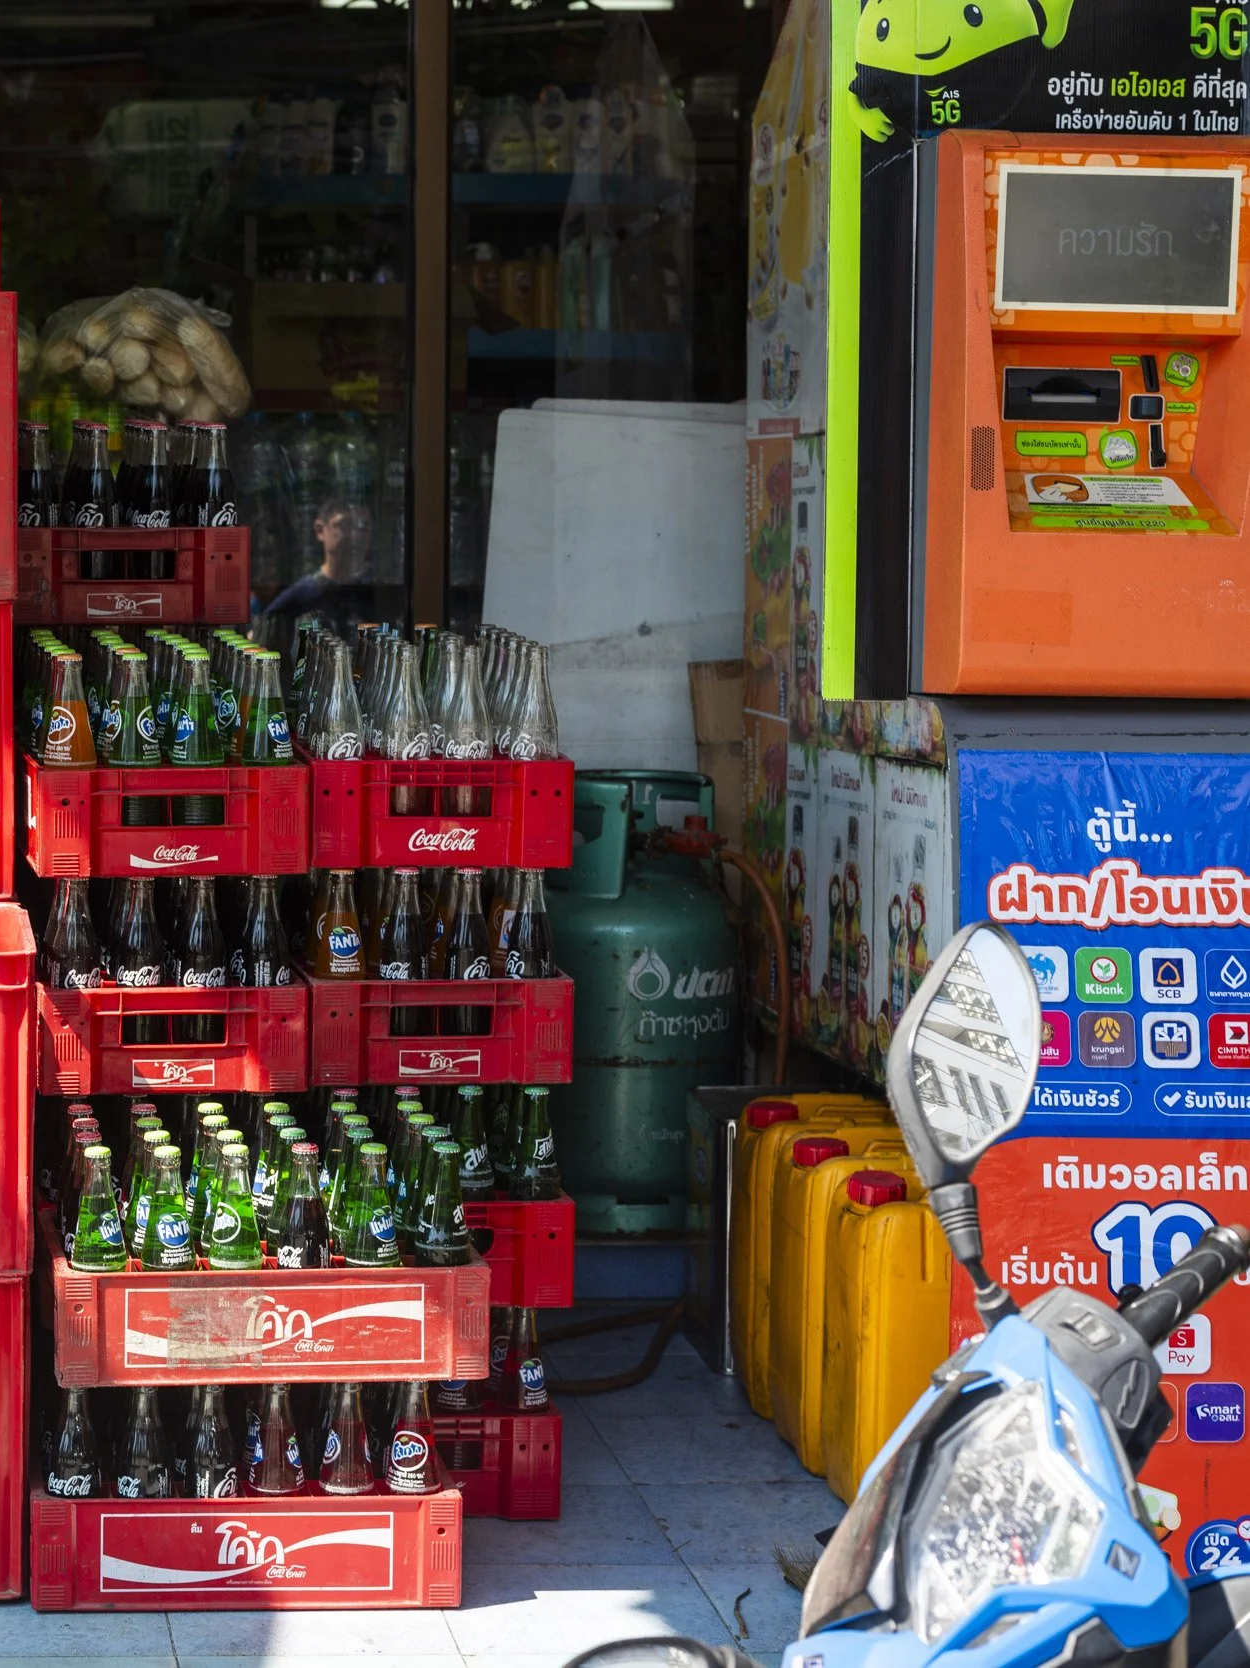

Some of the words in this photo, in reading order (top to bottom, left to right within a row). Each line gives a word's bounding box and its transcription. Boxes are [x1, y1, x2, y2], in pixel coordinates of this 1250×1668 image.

[1189, 6, 1249, 60] 5G
[942, 89, 960, 99] AIS
[1048, 70, 1104, 105] อยู่กับ
[1111, 71, 1186, 98] เอไอเอส
[1193, 67, 1248, 108] ดีที่สุด
[931, 99, 961, 125] 5G
[1055, 107, 1173, 131] เครือข่ายอันดับ
[1178, 114, 1186, 131] 1
[1192, 109, 1240, 132] ในไทย
[1058, 221, 1174, 257] ความรัก
[1140, 519, 1166, 528] 1220
[1086, 799, 1173, 853] ตู้นี้...
[408, 827, 479, 852] Coca-Cola
[153, 845, 199, 861] Coca-Cola
[183, 966, 226, 987] Coca-Cola
[1085, 983, 1124, 996] KBank
[1157, 989, 1182, 999] SCB
[429, 1052, 453, 1068] โค้ก
[1091, 1045, 1125, 1055] krungsri
[1217, 1047, 1239, 1055] CIMB
[162, 1062, 187, 1079] โค้ก
[1034, 1085, 1121, 1108] ได้เงินชัวร์
[1002, 1246, 1098, 1285] เริ่มต้น
[243, 1295, 313, 1340] โค้ก
[1168, 1350, 1195, 1367] Pay
[190, 1521, 203, 1534] ดื่ม
[214, 1520, 285, 1565] โค้ก
[1204, 1532, 1230, 1547] เปิด
[1199, 1547, 1242, 1570] 24
